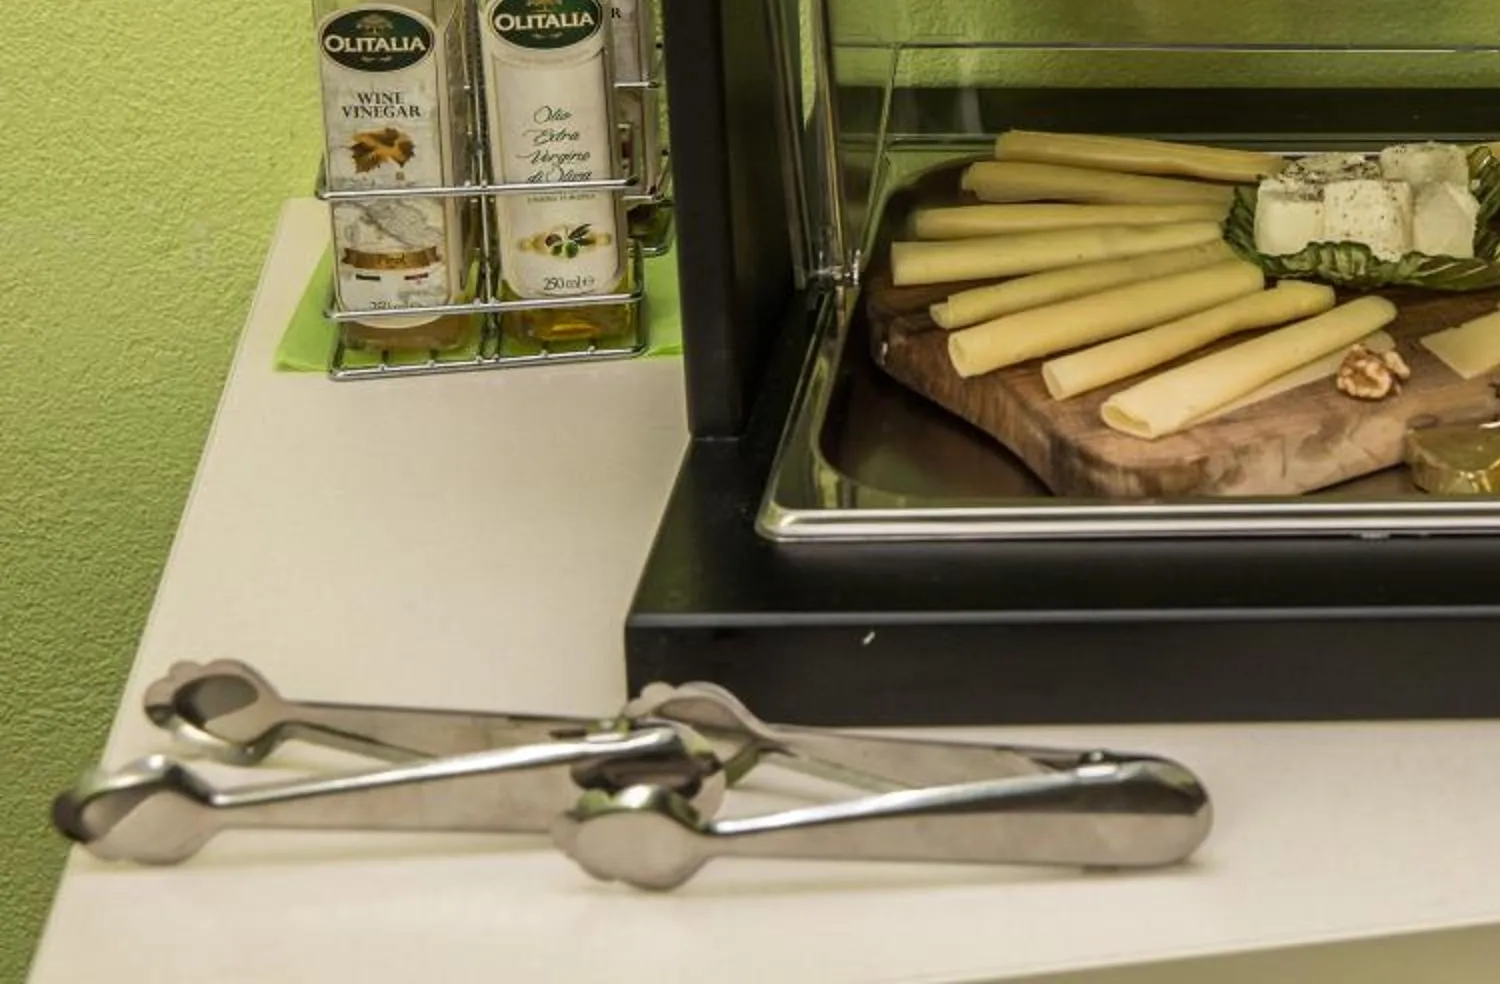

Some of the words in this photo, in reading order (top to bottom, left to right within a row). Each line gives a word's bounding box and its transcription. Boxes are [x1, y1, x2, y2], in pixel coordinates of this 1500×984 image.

[494, 12, 595, 32] OLITALIA
[323, 34, 427, 53] OLITALIA
[356, 92, 405, 105] WINE
[341, 104, 422, 118] VINEGAR
